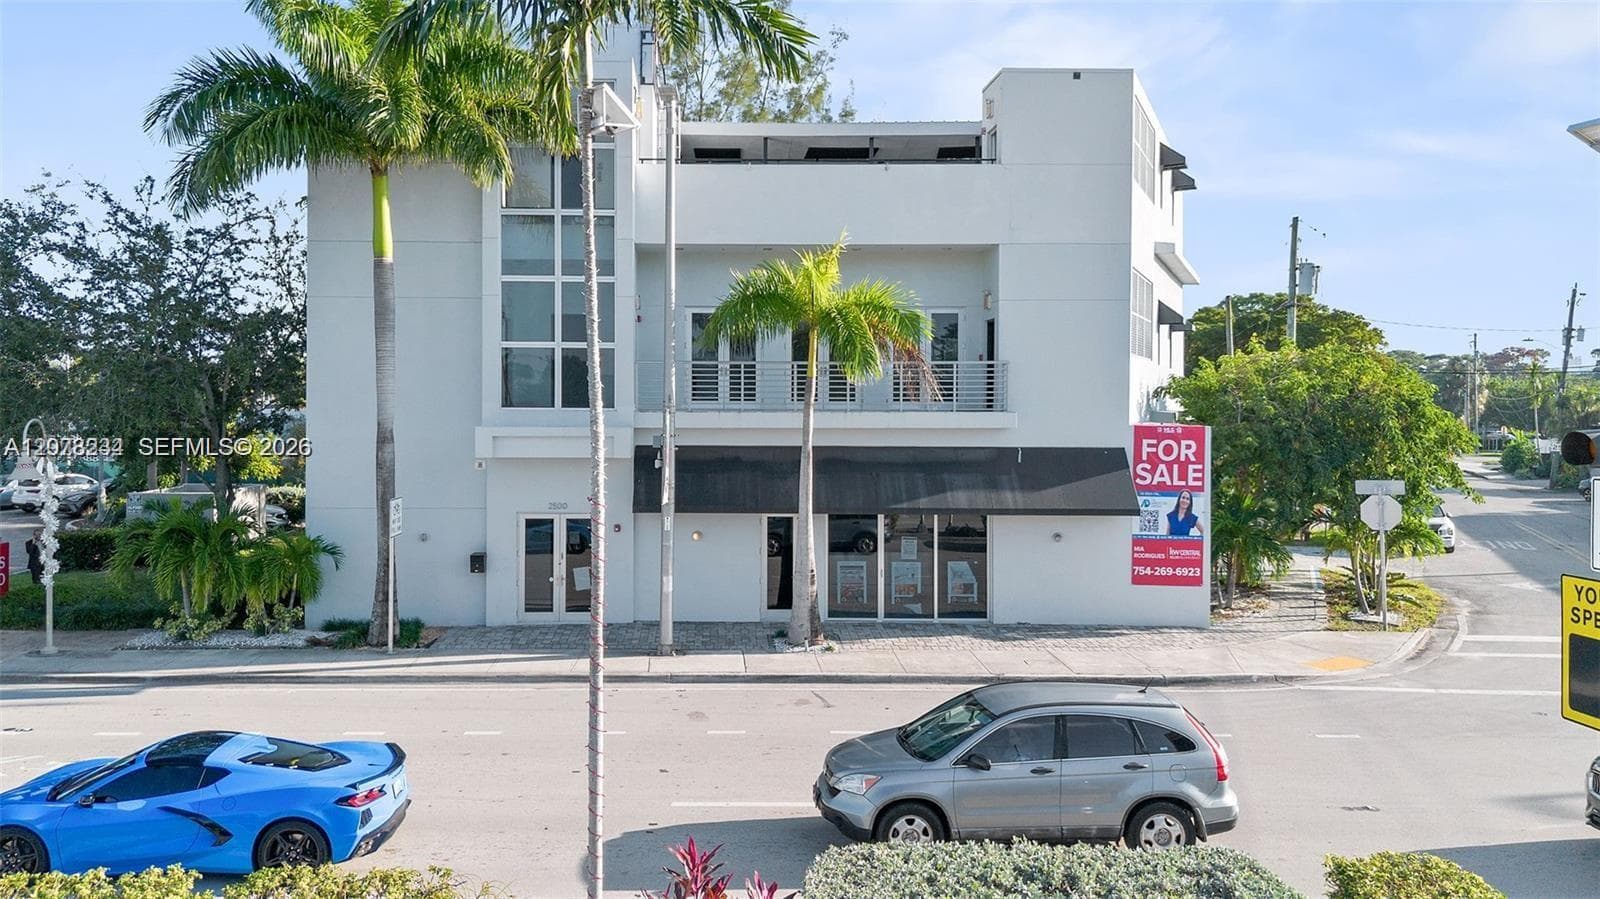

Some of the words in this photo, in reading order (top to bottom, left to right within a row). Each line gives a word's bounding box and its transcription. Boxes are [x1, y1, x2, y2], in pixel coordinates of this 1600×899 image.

[1141, 439, 1197, 462] FOR
[1135, 463, 1203, 486] SALE
[548, 502, 569, 510] 2500
[1132, 566, 1201, 577] 754-269-6923
[1574, 584, 1600, 605] YO
